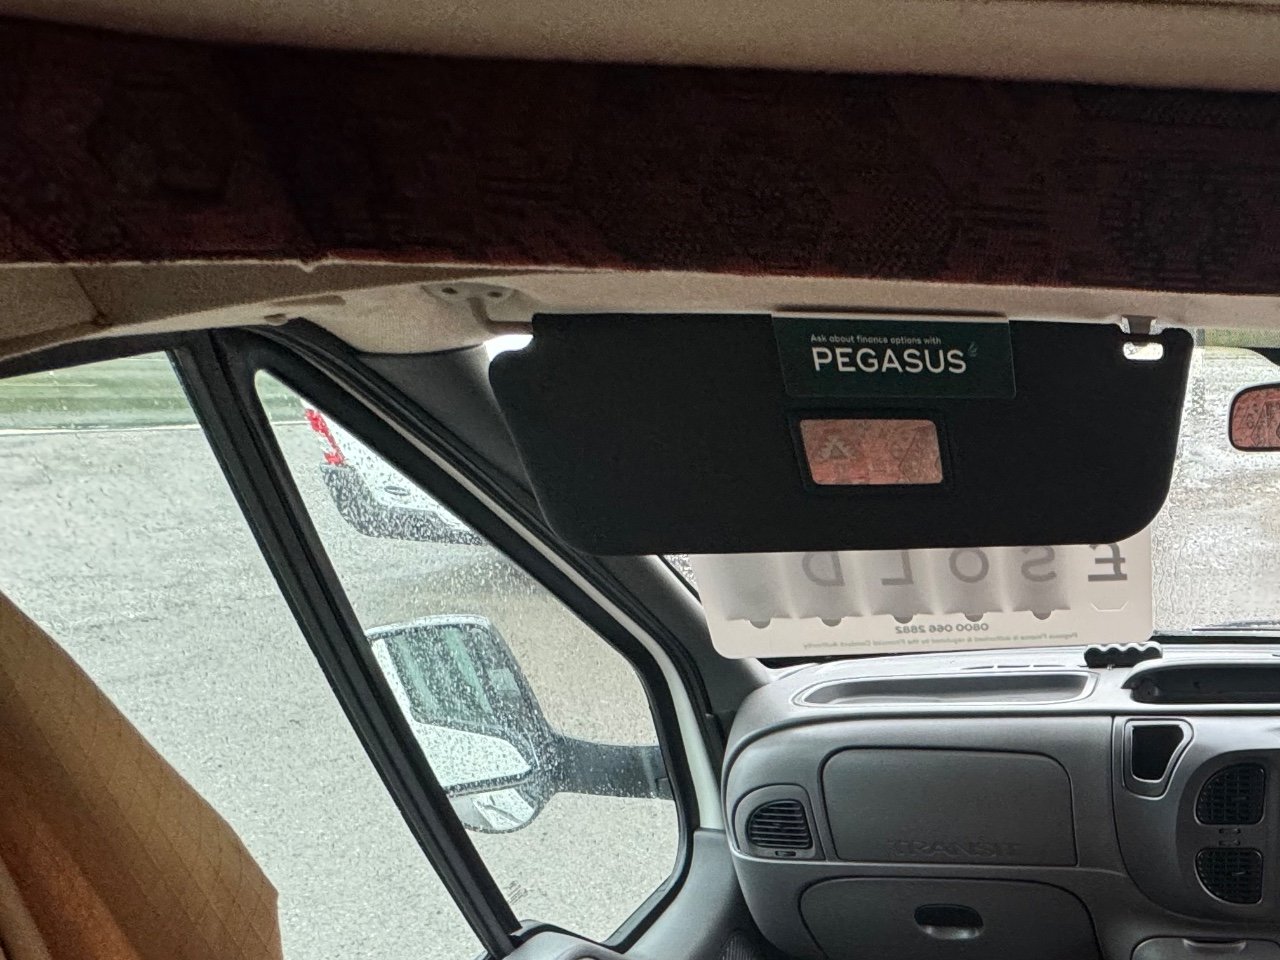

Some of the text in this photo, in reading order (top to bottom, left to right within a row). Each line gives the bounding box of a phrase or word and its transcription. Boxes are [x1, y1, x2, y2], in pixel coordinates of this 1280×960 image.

[811, 334, 942, 346] Ask about finance options with
[811, 346, 967, 374] PEGASUS
